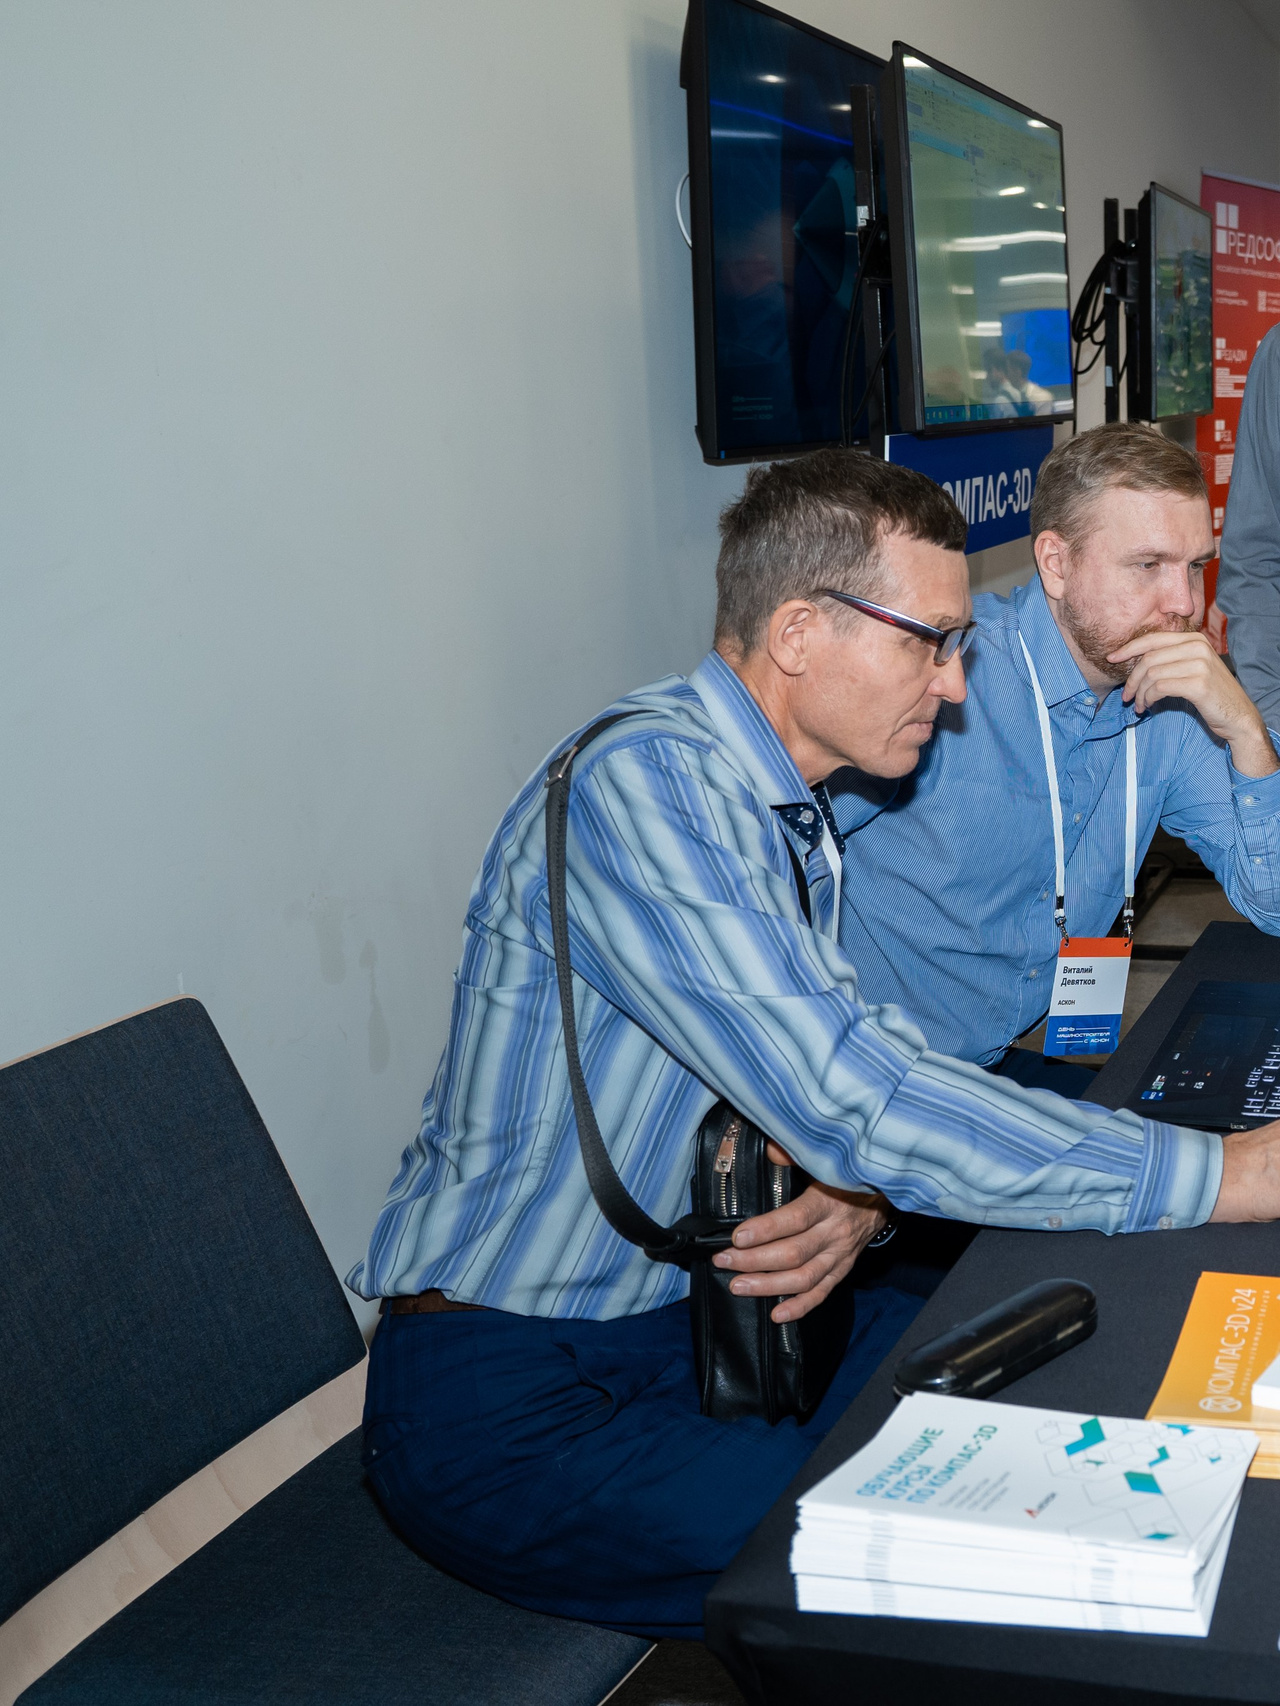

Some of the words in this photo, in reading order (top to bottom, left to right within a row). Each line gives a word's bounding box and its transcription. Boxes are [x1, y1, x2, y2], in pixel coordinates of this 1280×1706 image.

[940, 468, 1032, 525] МПАС-3D
[1061, 977, 1095, 986] Девятков
[1063, 965, 1093, 974] Виталий
[1206, 1313, 1251, 1396] КОМПАС-3D
[1231, 1288, 1257, 1312] v24
[856, 1427, 944, 1497] ОБУЧАЮЩИЕ
[881, 1464, 935, 1501] КУРСЫ
[906, 1487, 936, 1504] ПО
[927, 1424, 998, 1490] КОМПАС-3D
